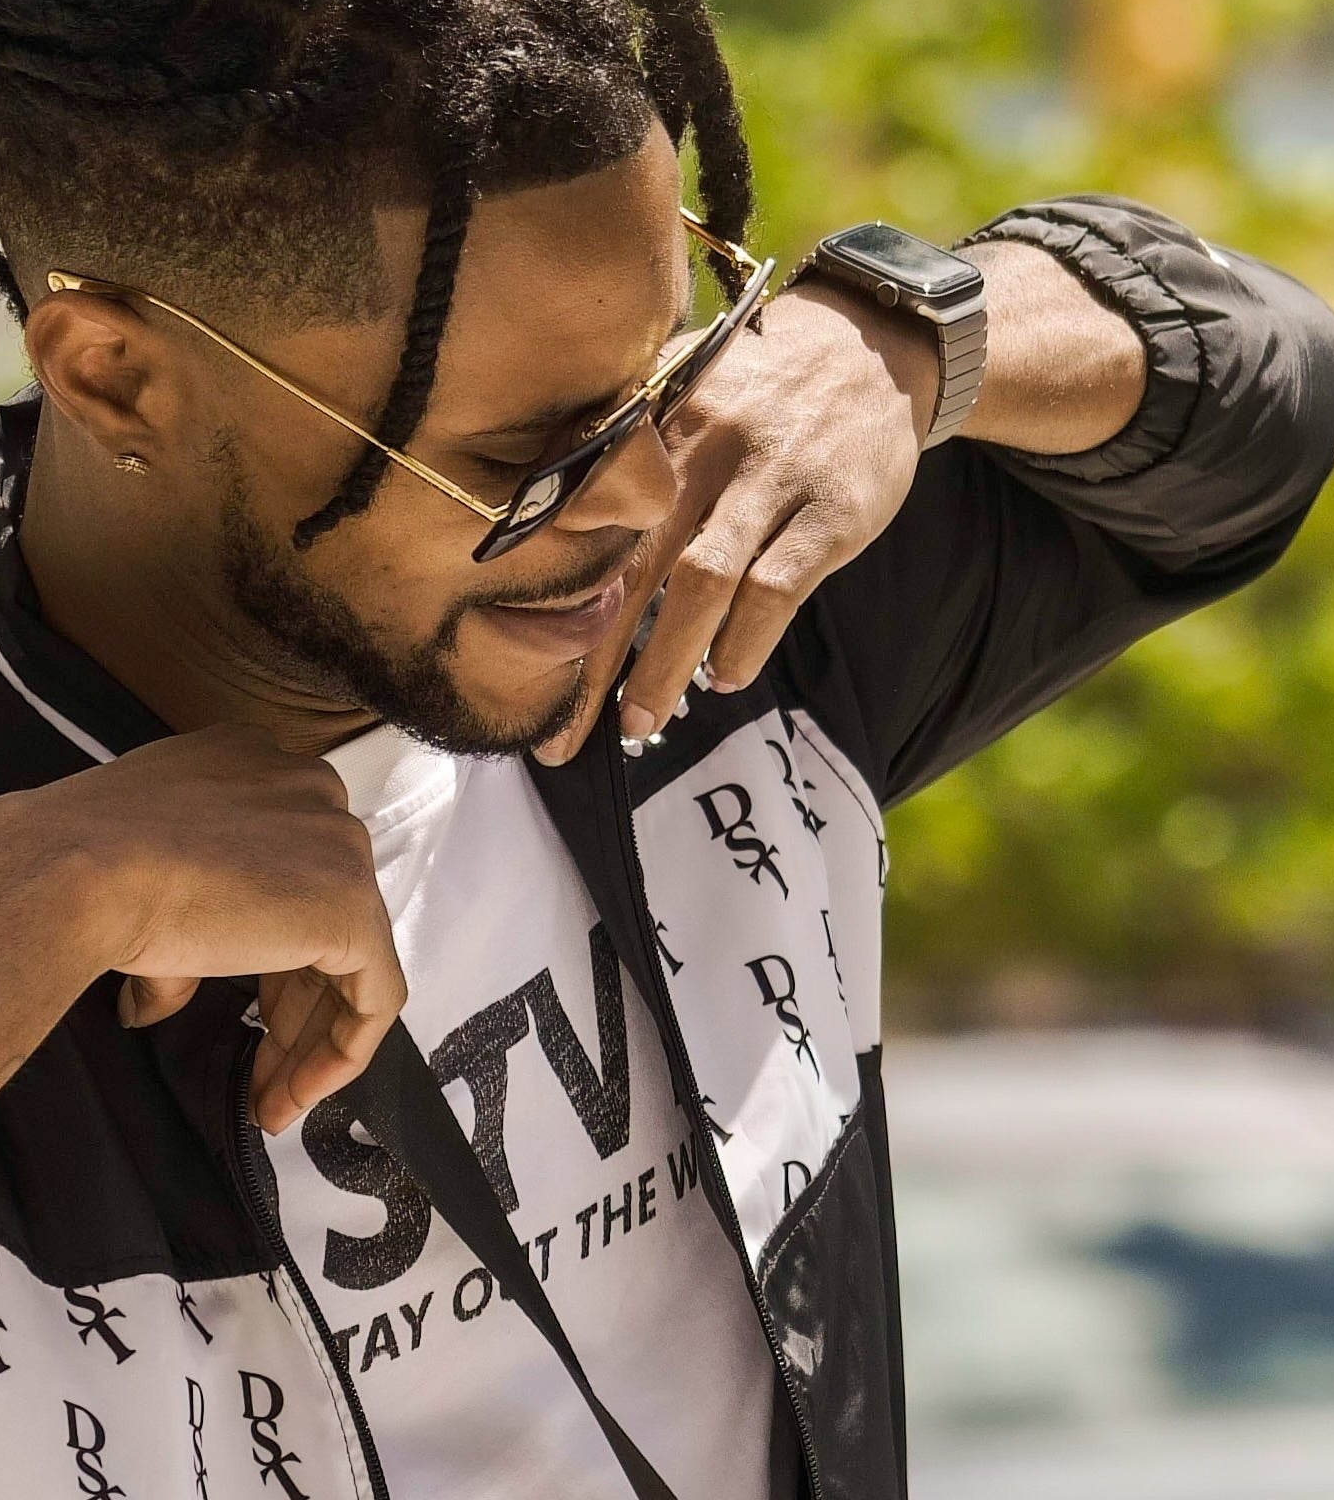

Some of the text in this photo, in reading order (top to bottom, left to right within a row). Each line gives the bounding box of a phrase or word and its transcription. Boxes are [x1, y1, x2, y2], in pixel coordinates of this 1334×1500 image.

[332, 1291, 434, 1373] TAY
[452, 1227, 558, 1322] OT
[576, 1167, 656, 1260] THE
